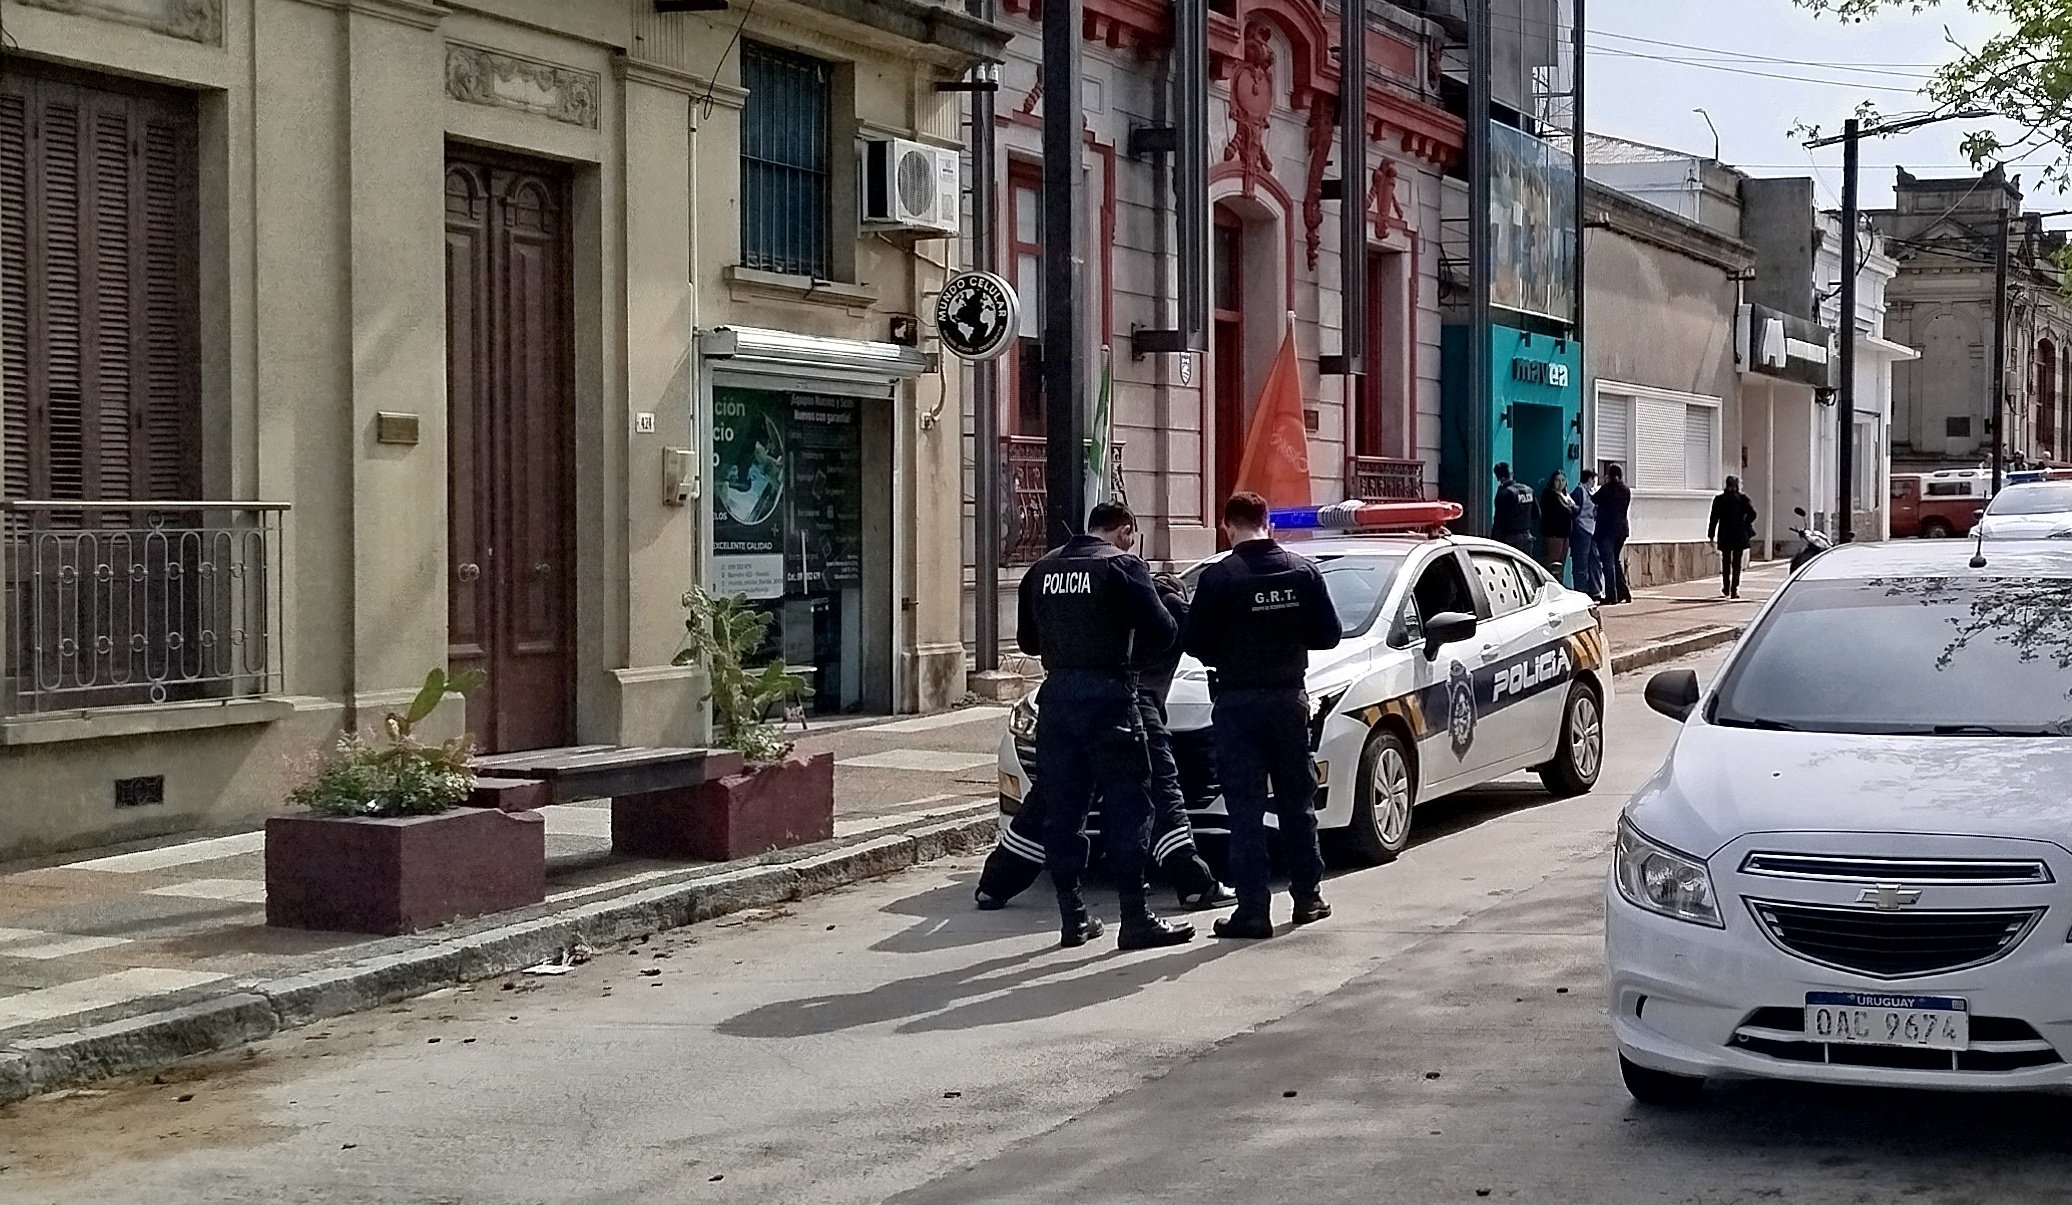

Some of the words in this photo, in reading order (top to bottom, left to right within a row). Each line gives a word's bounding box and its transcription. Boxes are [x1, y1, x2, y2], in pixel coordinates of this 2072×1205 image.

[938, 279, 965, 321] MUNDO
[969, 277, 1007, 317] CELULAR
[1513, 357, 1569, 387] mavea
[714, 397, 746, 416] ción
[713, 421, 735, 442] cio
[746, 541, 773, 550] CALIDAD
[1042, 571, 1092, 595] POLICIA
[1254, 589, 1297, 604] G.R.T.
[1492, 647, 1572, 703] POLICIA
[1857, 996, 1915, 1008] URUGUAY
[1885, 1013, 1957, 1042] 9674
